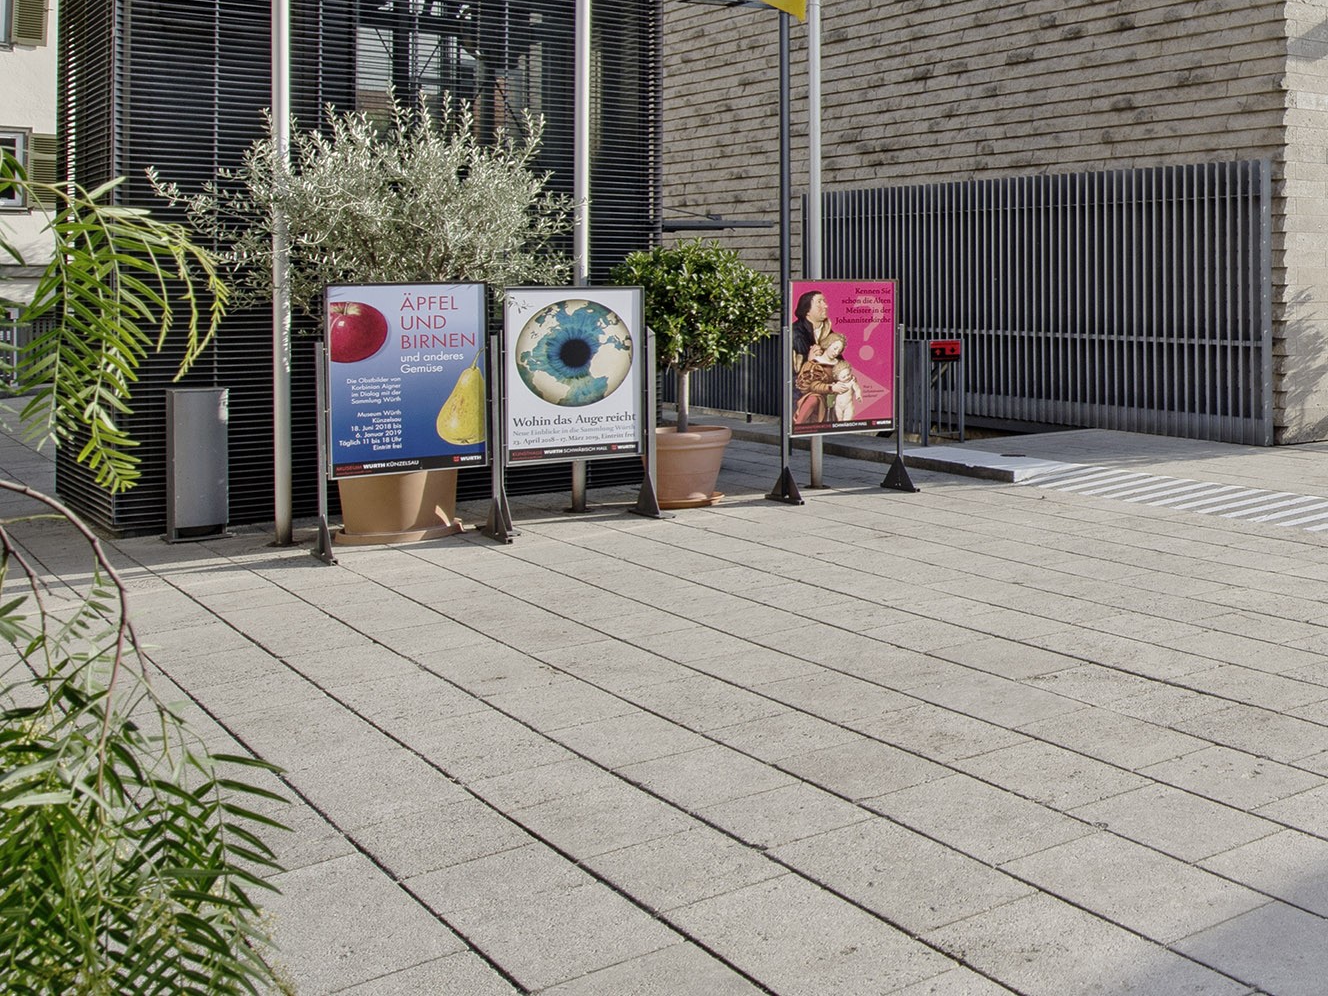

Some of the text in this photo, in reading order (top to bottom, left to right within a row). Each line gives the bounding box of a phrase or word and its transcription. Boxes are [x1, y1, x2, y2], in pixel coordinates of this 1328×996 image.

[400, 292, 459, 311] ÄPFEL
[401, 315, 447, 330] UND
[835, 316, 891, 325] Johanniterkirche
[401, 333, 475, 349] BIRNEN
[400, 351, 464, 363] und anderes
[400, 363, 443, 374] Gemüse
[513, 411, 636, 427] Wohin das Auge reicht
[530, 428, 560, 436] Einblicke
[580, 425, 614, 434] Sammlung
[339, 439, 361, 447] Täglich
[523, 437, 540, 445] April
[386, 459, 419, 468] KÜNZELSAU
